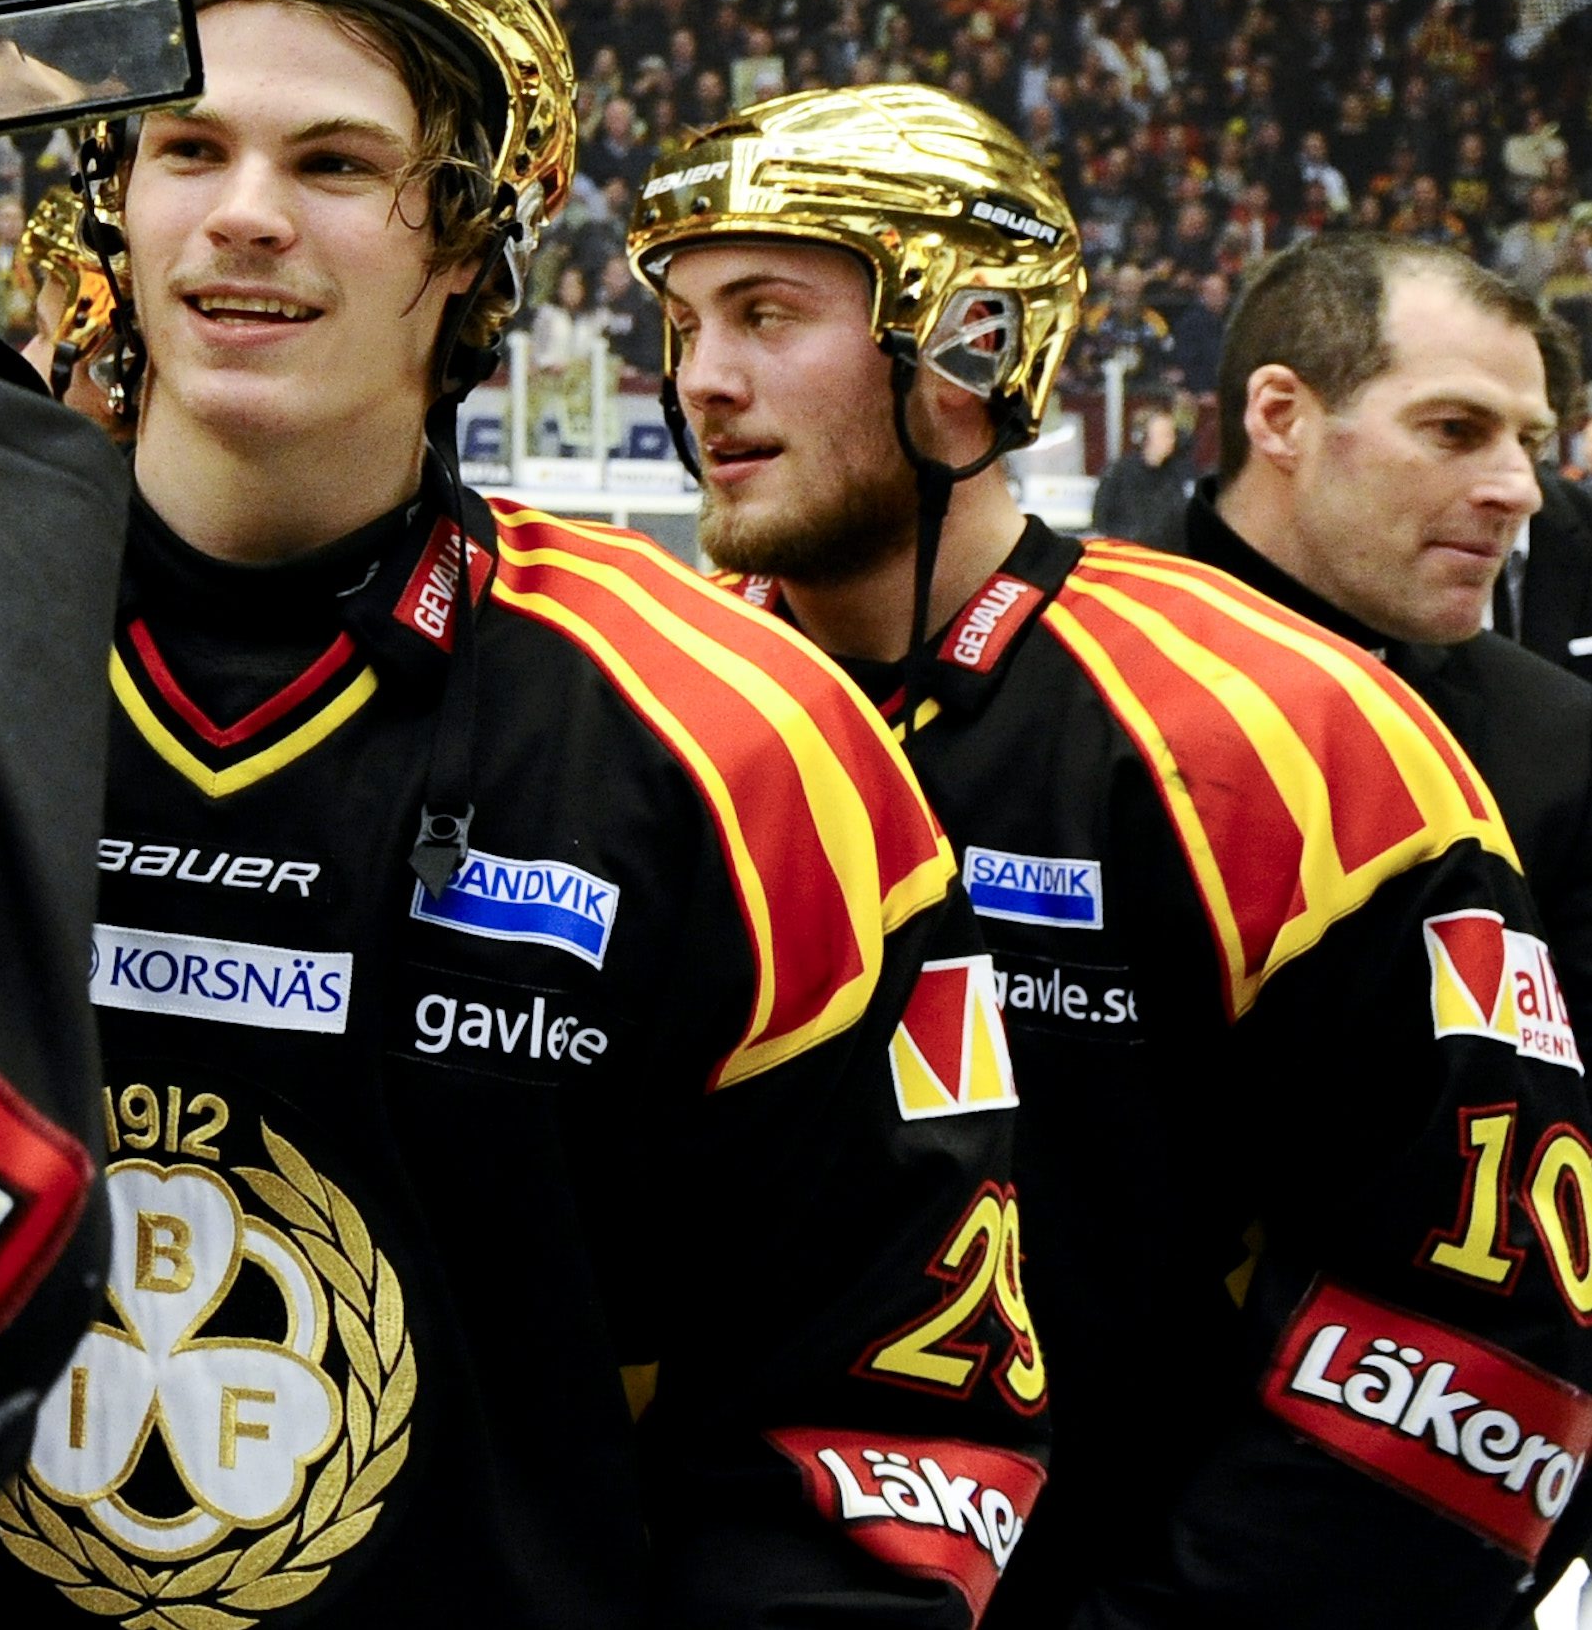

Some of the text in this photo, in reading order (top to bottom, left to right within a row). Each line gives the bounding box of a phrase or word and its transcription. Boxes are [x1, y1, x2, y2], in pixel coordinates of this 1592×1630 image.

[641, 160, 730, 200] BAUER
[971, 201, 1059, 244] BAUER
[952, 578, 1029, 666] GEVALIA
[97, 838, 321, 899] BAUER
[109, 945, 343, 1014] KORSNÄS
[102, 1083, 229, 1161] 1912
[134, 1209, 196, 1294] B
[1429, 1102, 1592, 1326] 10
[219, 1386, 277, 1470] F
[817, 1447, 1024, 1568] Läke
